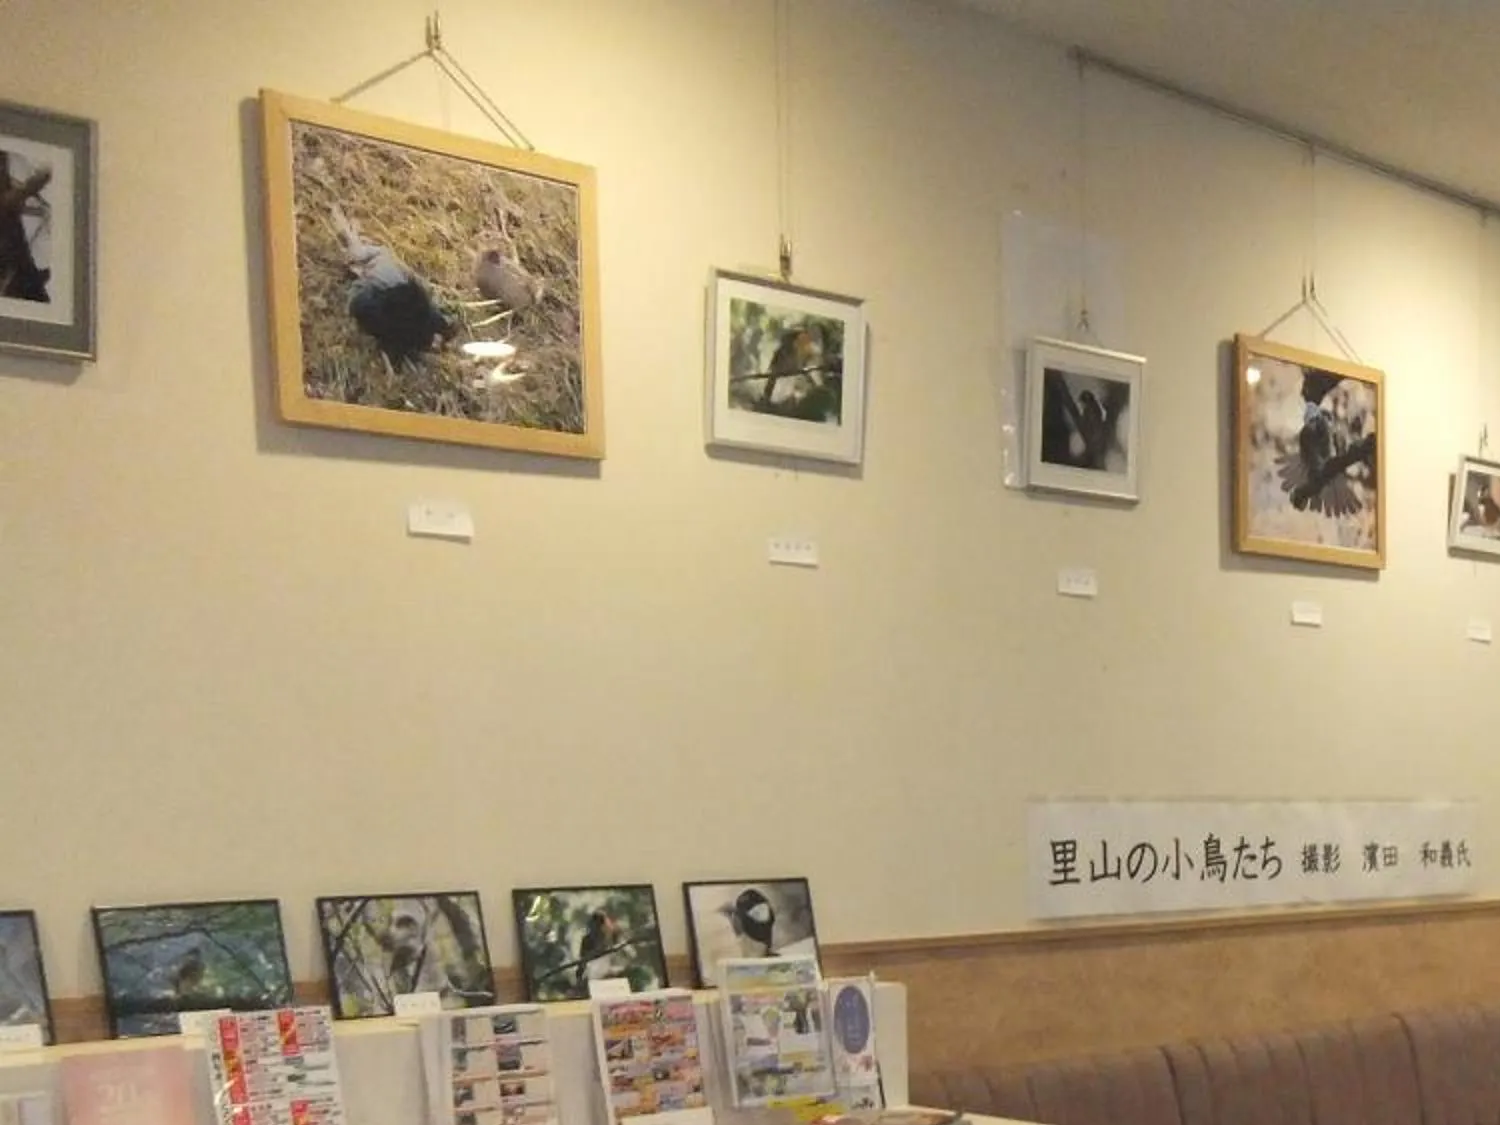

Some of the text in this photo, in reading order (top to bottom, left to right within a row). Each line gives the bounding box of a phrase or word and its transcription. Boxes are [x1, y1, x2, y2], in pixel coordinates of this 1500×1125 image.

[1049, 833, 1283, 886] 里山の小鳥たち
[1301, 842, 1341, 873] 撮影
